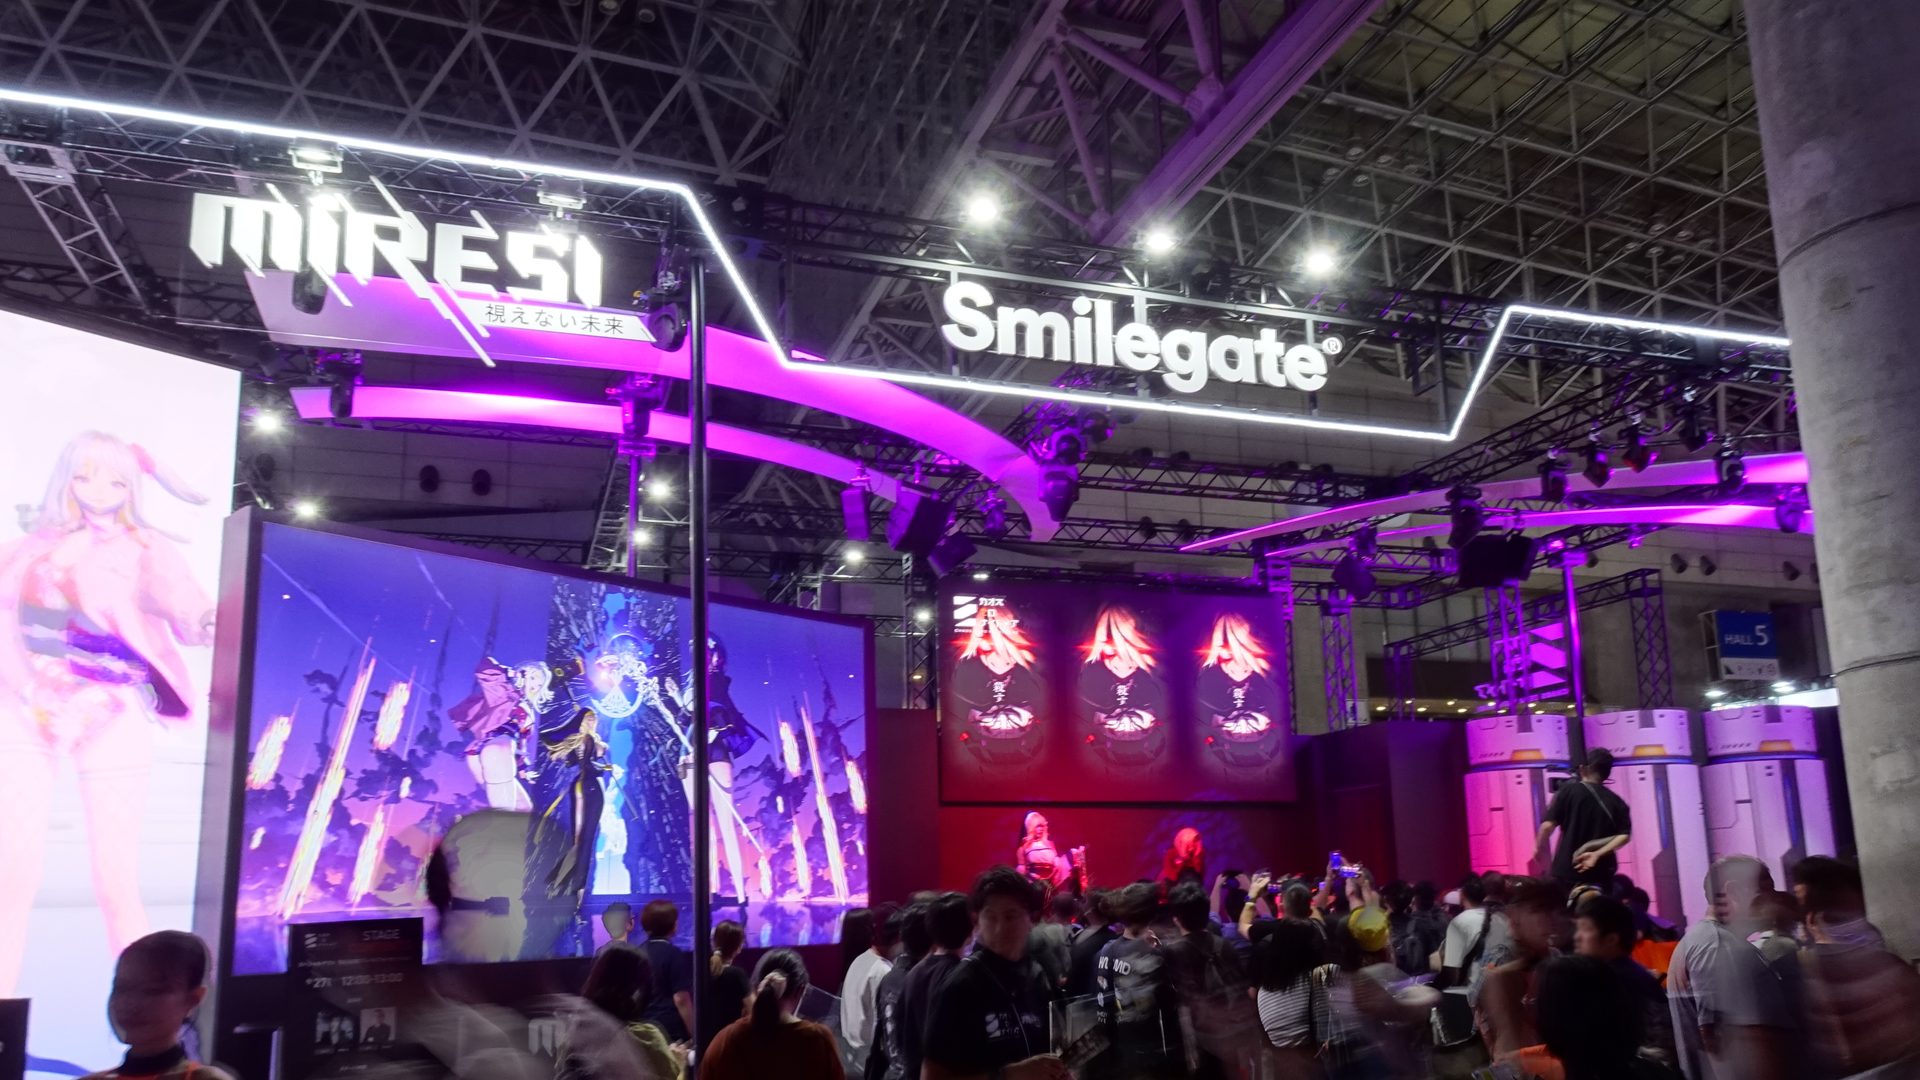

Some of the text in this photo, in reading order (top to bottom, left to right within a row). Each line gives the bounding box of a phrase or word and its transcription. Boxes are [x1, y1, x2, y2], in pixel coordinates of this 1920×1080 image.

[485, 304, 623, 335] 視えない未来
[1724, 625, 1769, 646] HALL 5
[363, 929, 400, 941] STAGE
